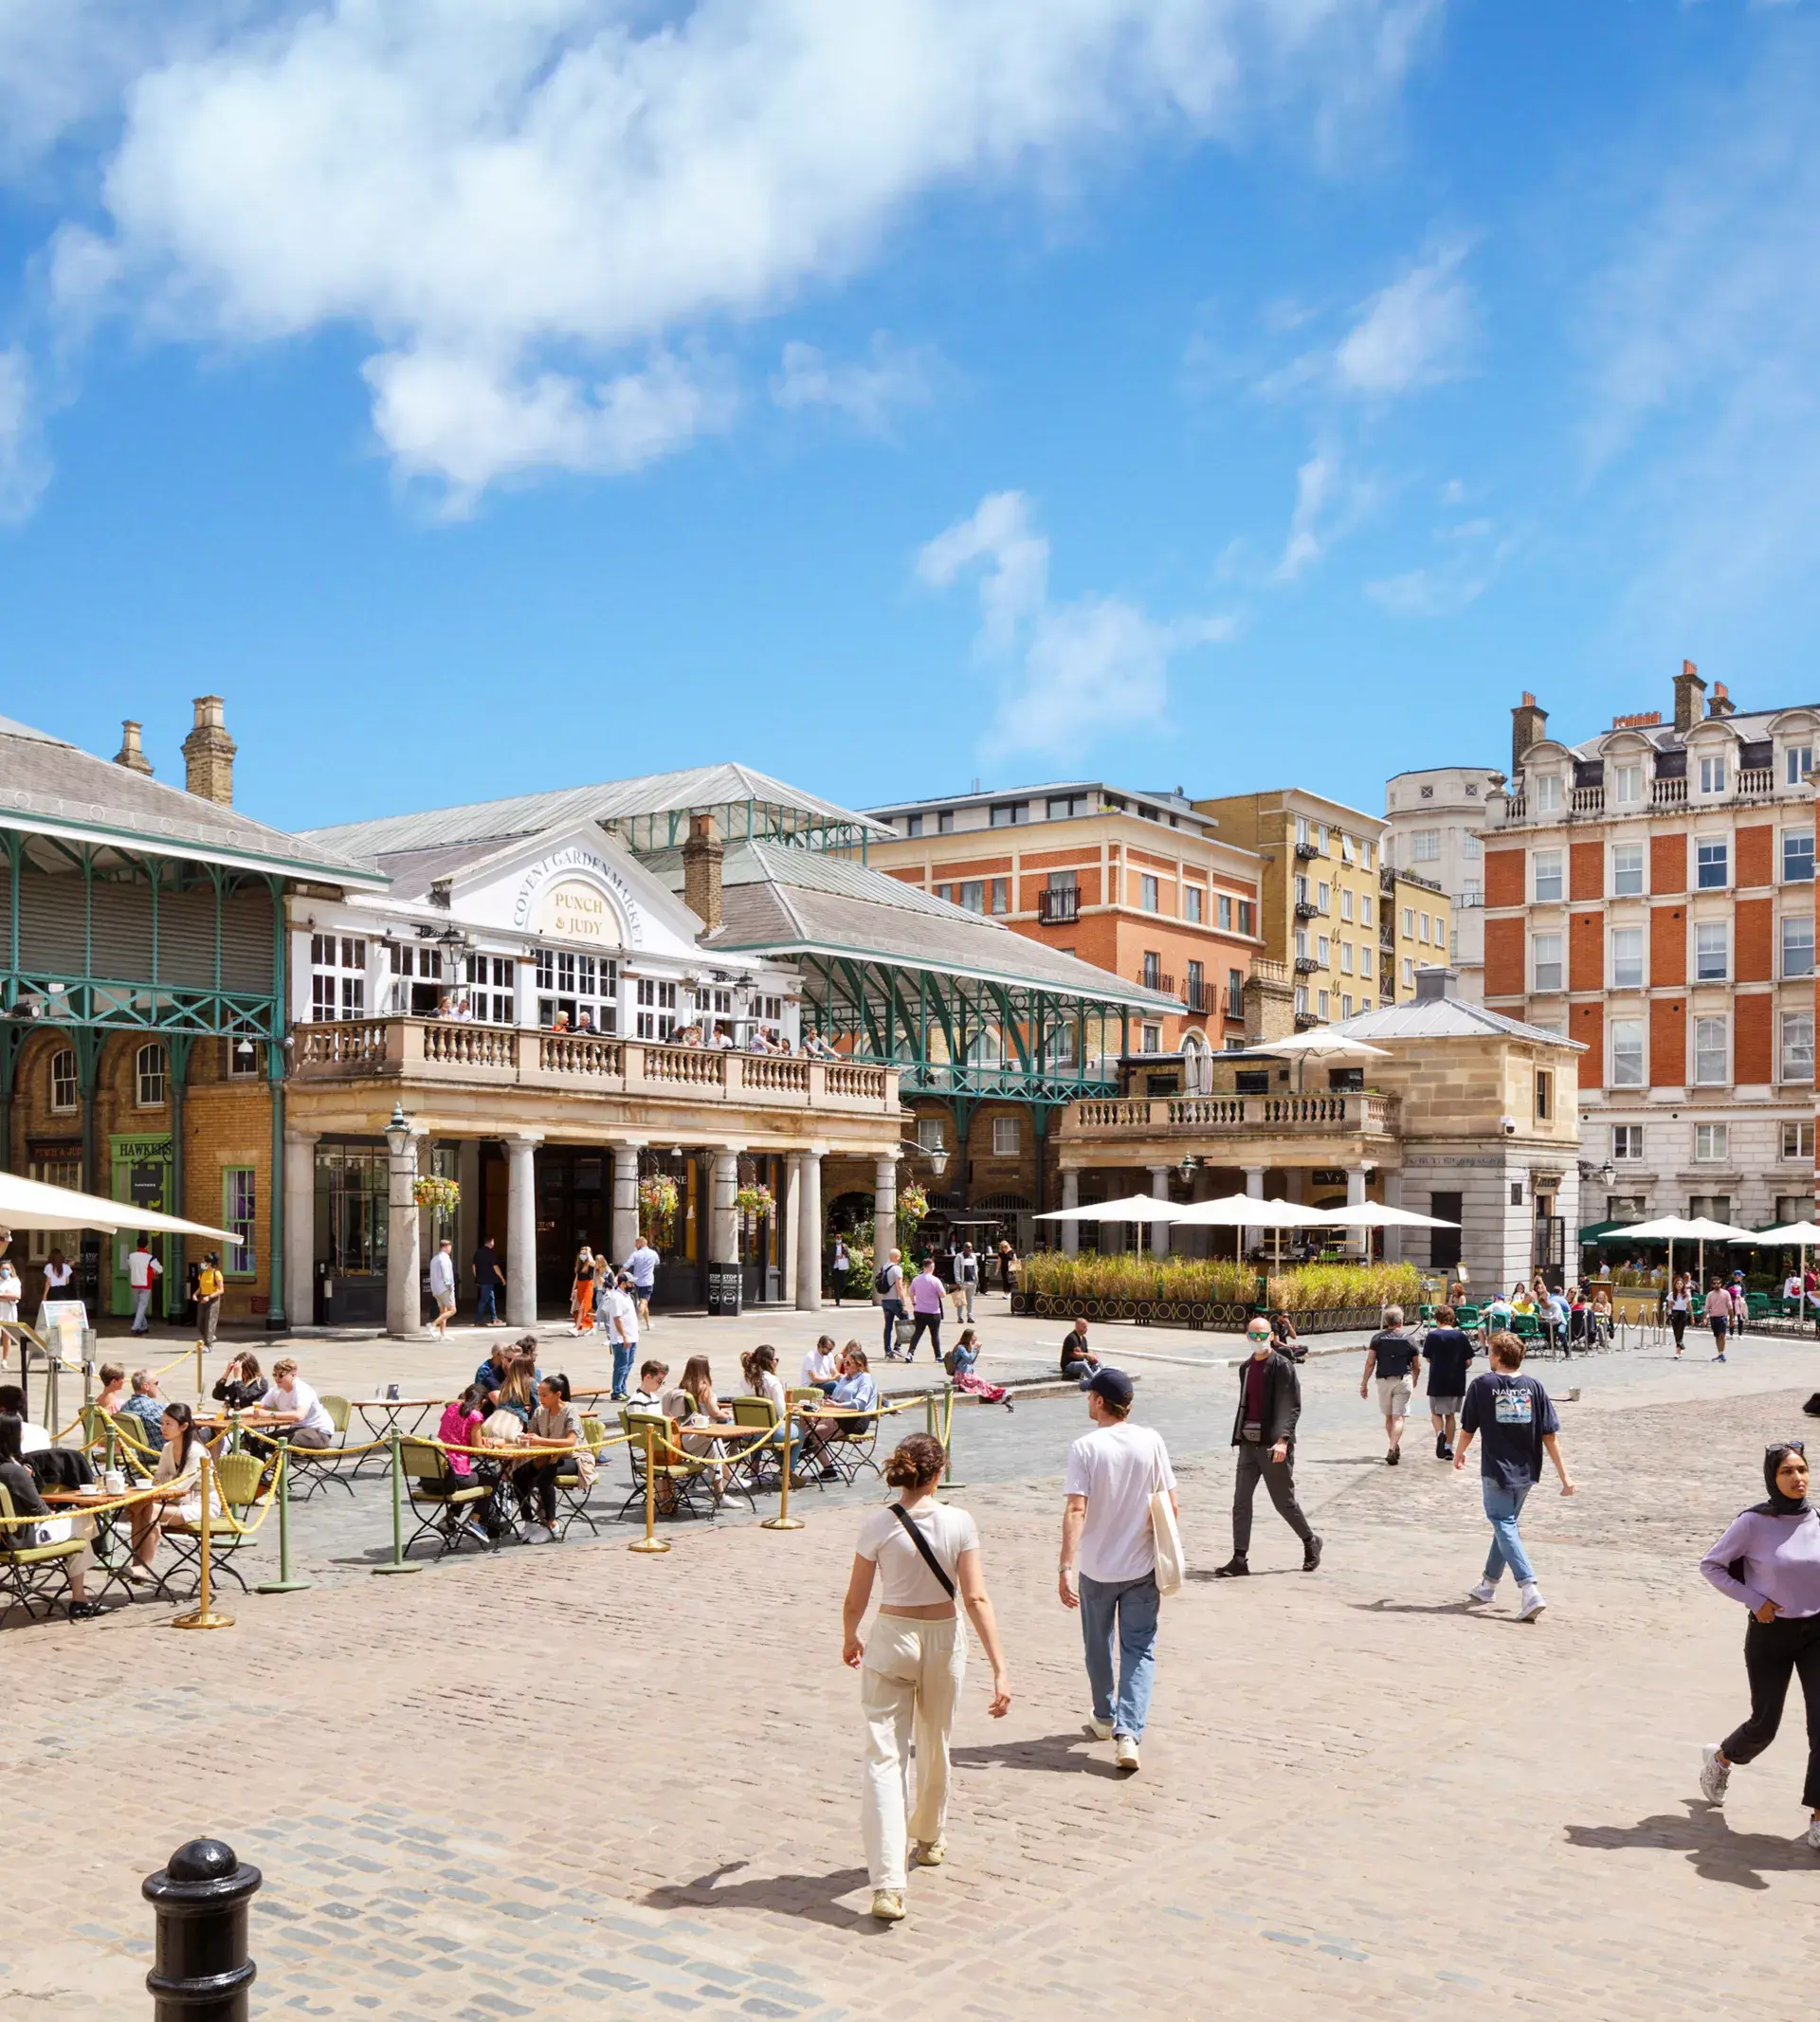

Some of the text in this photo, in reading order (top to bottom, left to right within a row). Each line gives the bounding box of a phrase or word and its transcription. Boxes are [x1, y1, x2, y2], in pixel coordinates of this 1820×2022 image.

[514, 849, 643, 943] COVENT GARDEN MARKET
[555, 893, 603, 914] PUNCH
[555, 917, 603, 936] & JUDY
[1492, 1388, 1534, 1396] NAUTICA
